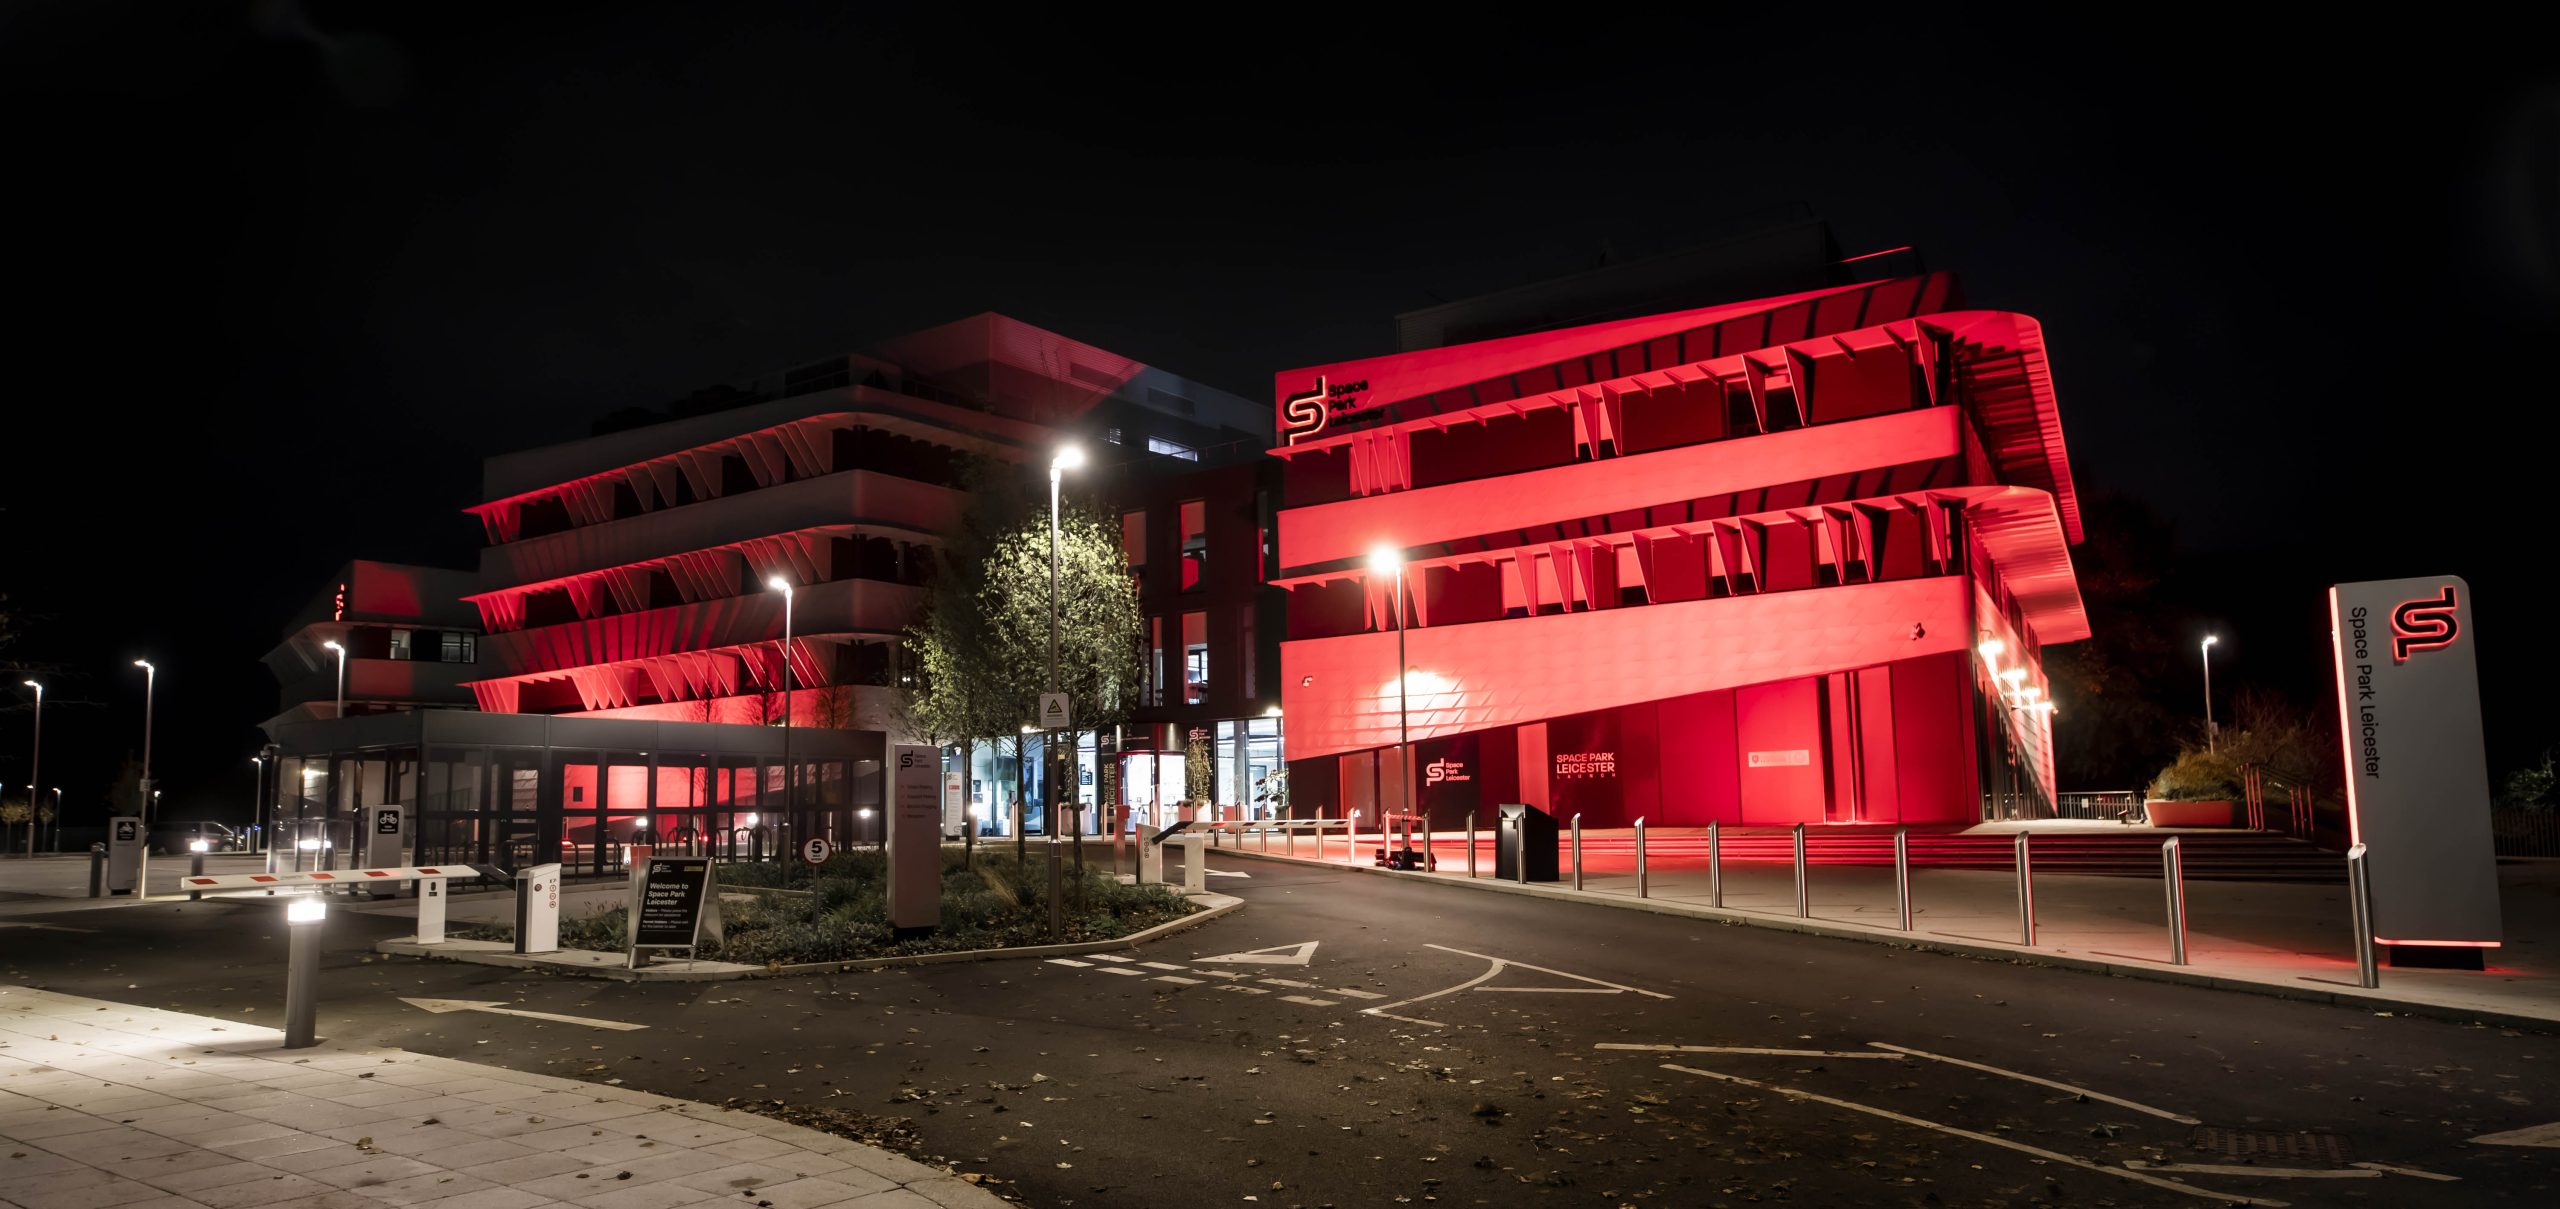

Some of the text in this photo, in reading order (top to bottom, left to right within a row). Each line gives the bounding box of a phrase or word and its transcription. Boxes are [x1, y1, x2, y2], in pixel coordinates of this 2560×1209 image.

[1328, 379, 1368, 398] Space
[1328, 396, 1356, 412] Park
[2349, 607, 2380, 779] Space Park Leicester
[1556, 752, 1615, 763] SPACE PARK
[1556, 762, 1615, 774] LEICESTER
[811, 841, 823, 854] 5
[648, 890, 686, 899] Space Park
